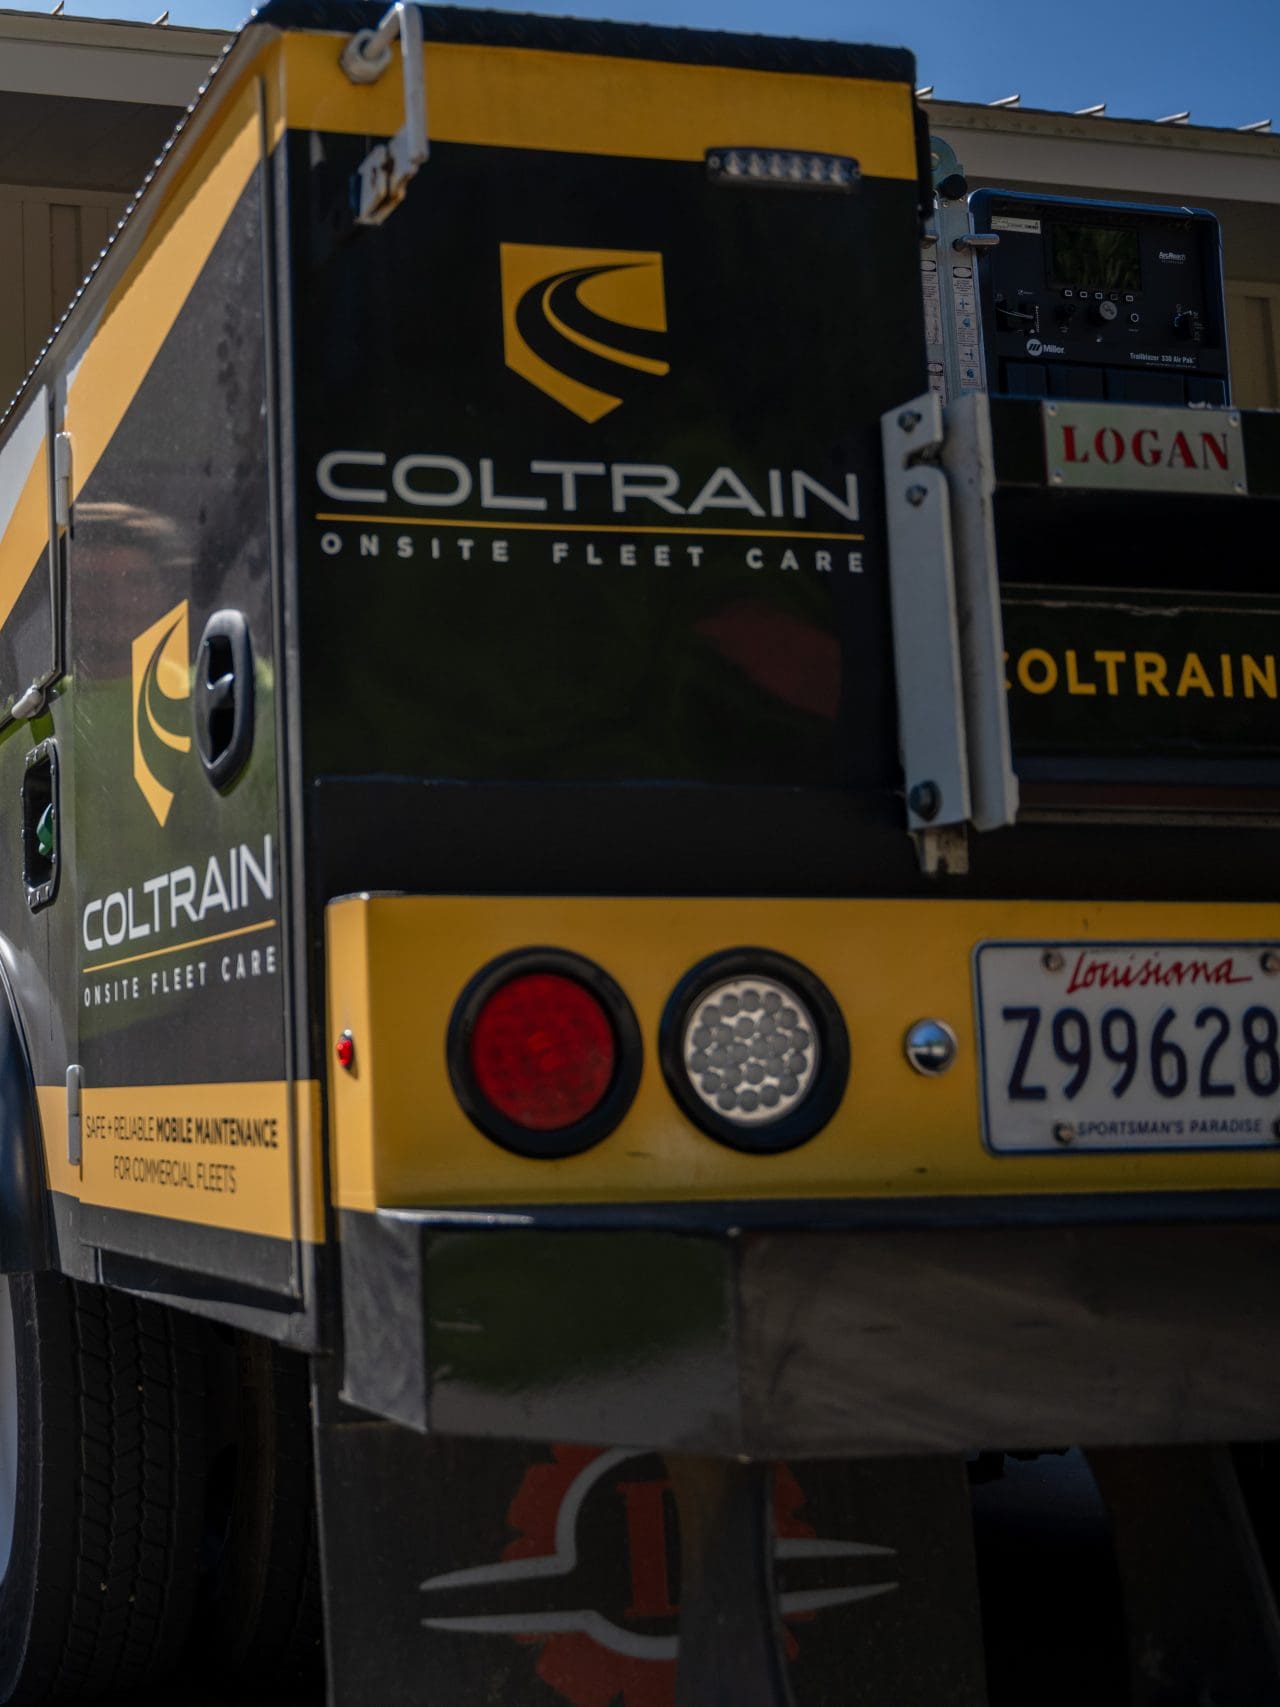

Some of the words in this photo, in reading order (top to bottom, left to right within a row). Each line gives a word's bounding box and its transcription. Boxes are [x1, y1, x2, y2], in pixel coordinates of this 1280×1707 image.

[1043, 344, 1065, 353] Miller
[1061, 425, 1230, 471] LOGAN
[316, 450, 860, 522] COLTRAIN
[320, 532, 509, 563] ONSITE
[552, 542, 704, 568] FLEET
[745, 547, 864, 574] CARE
[82, 833, 274, 952] COLTRAIN
[84, 976, 140, 1008] ONSITE
[151, 961, 207, 995] FLEET
[221, 945, 277, 982] CARE
[1066, 951, 1253, 995] Louisiana
[1002, 1005, 1280, 1101] Z99628
[86, 1115, 107, 1140] SAFE
[114, 1115, 155, 1142] RELIABLE
[156, 1117, 193, 1144] MOBILE
[195, 1116, 279, 1149] MAINTENANCE
[1076, 1119, 1184, 1137] SPORTSMAN'S
[1190, 1118, 1264, 1134] PARADISE
[114, 1154, 131, 1181] FOR
[132, 1157, 195, 1190] COMMERCIAL
[196, 1161, 237, 1194] FLEETS
